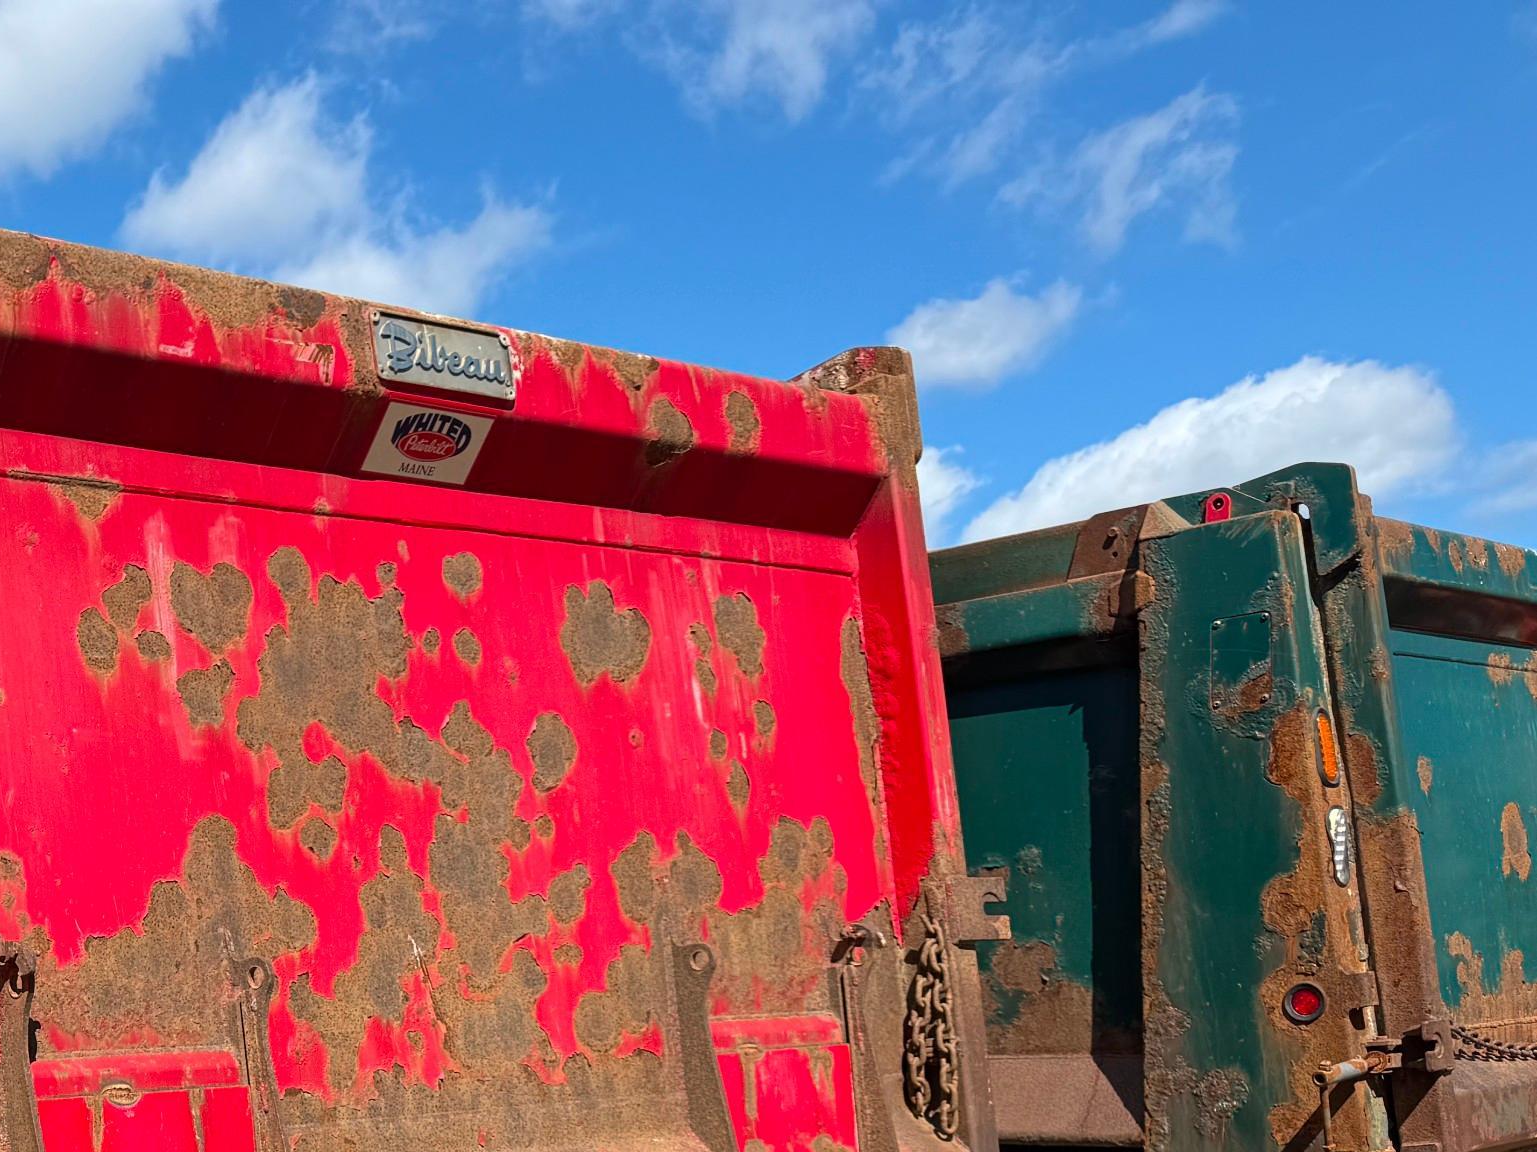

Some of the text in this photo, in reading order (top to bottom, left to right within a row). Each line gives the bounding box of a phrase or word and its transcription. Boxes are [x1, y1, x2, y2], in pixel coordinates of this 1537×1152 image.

[381, 321, 506, 384] Bibeau
[391, 413, 472, 456] WHITED
[404, 436, 455, 455] Peterbilt
[397, 461, 437, 477] MAINE
